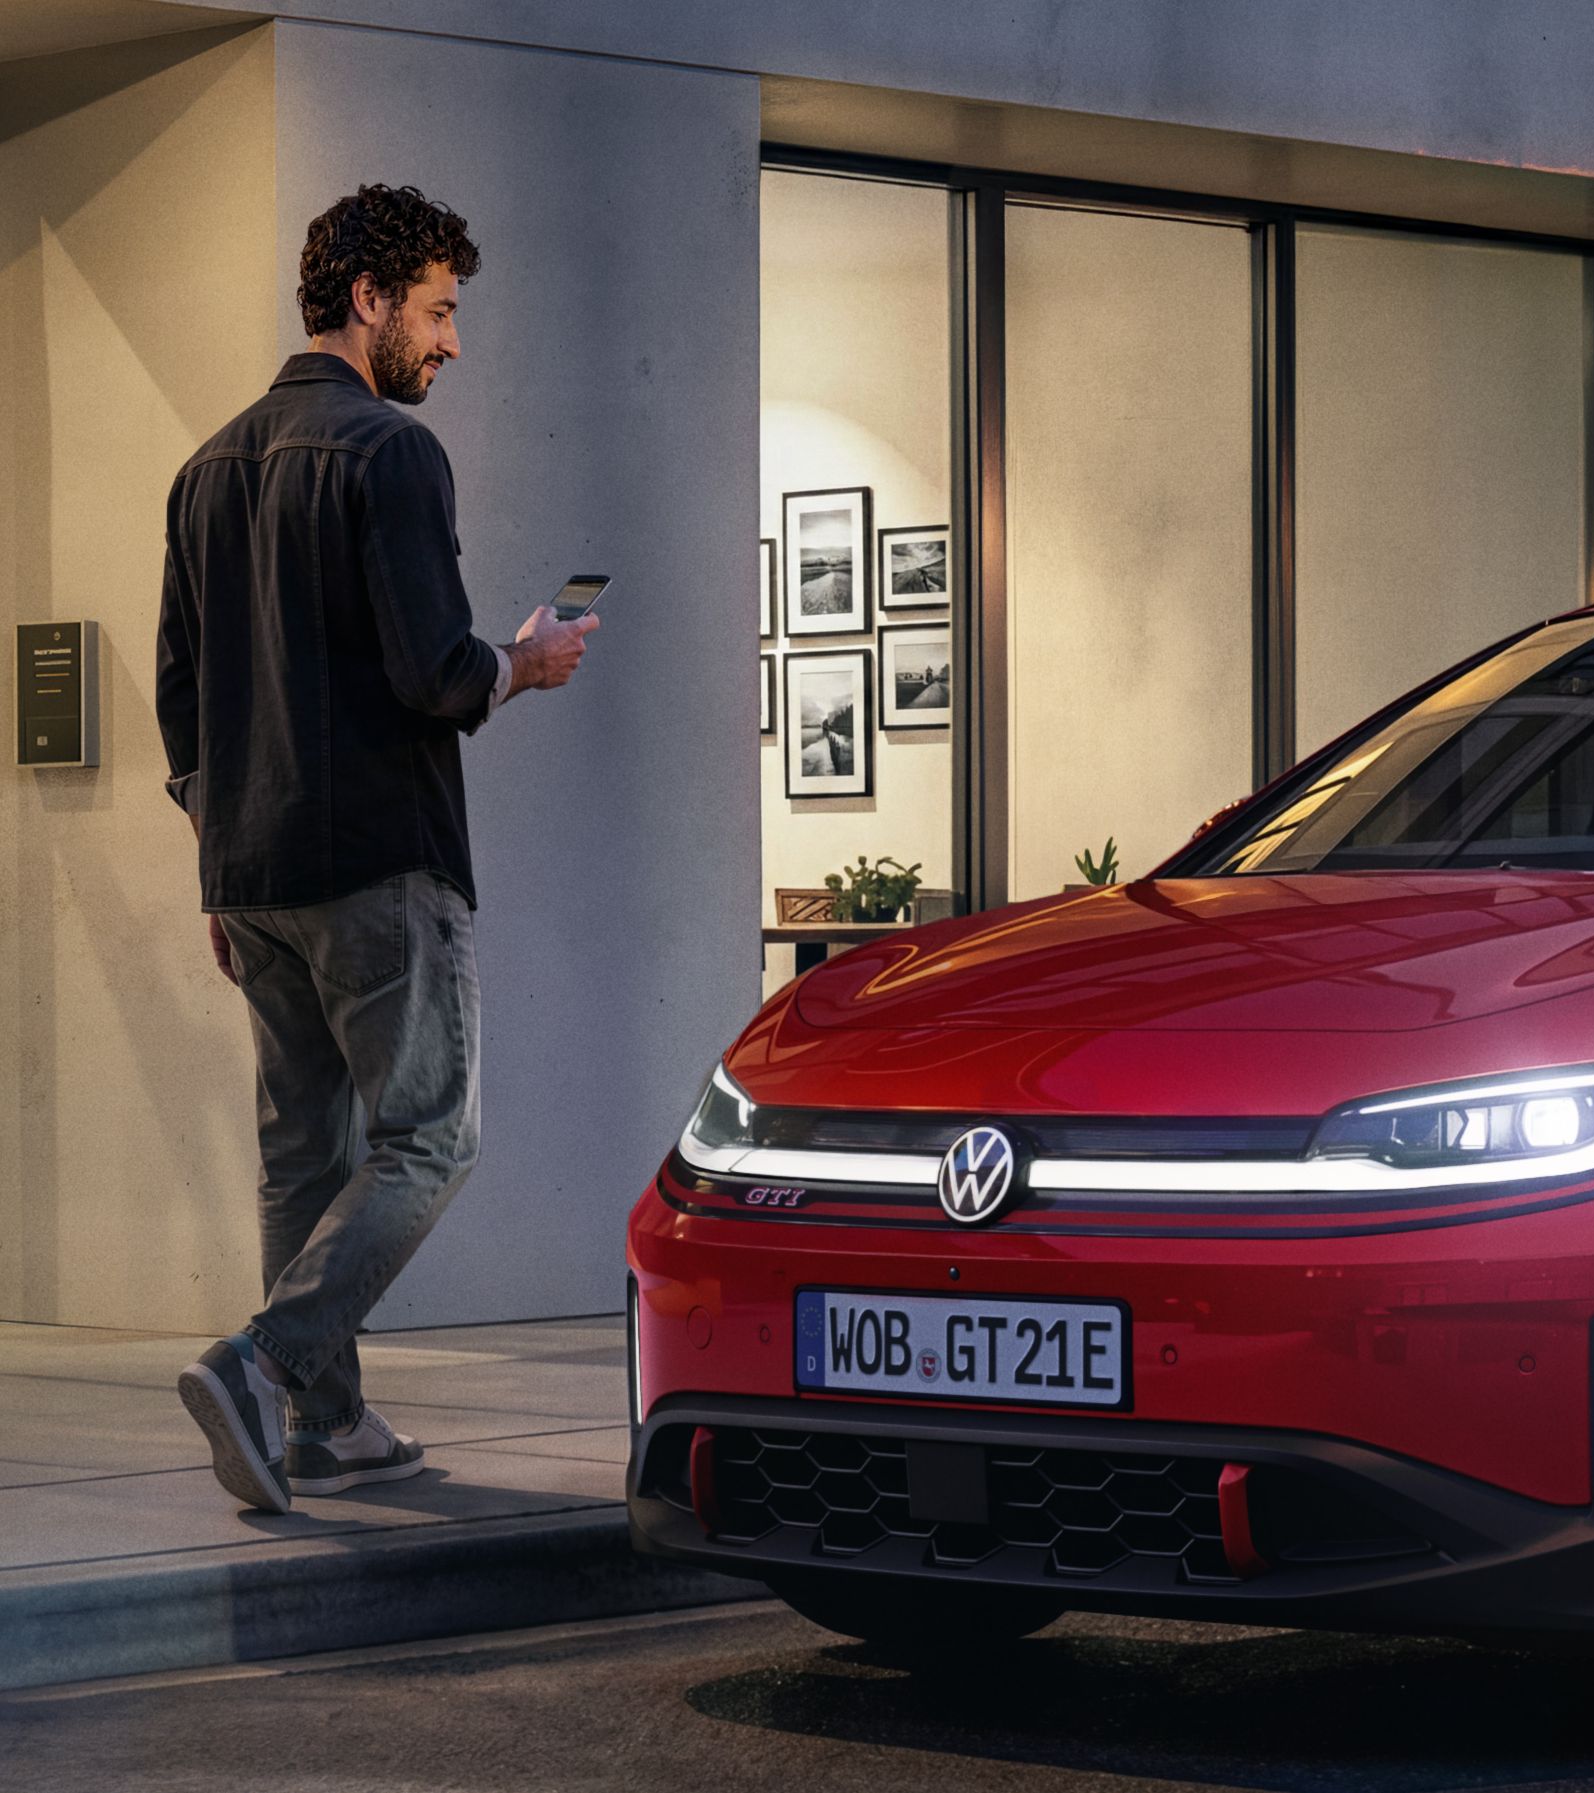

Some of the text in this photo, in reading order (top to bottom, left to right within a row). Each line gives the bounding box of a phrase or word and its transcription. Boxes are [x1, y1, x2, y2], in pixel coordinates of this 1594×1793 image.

[744, 1186, 806, 1207] GTI
[829, 1306, 912, 1377] WOB
[806, 1355, 817, 1372] D
